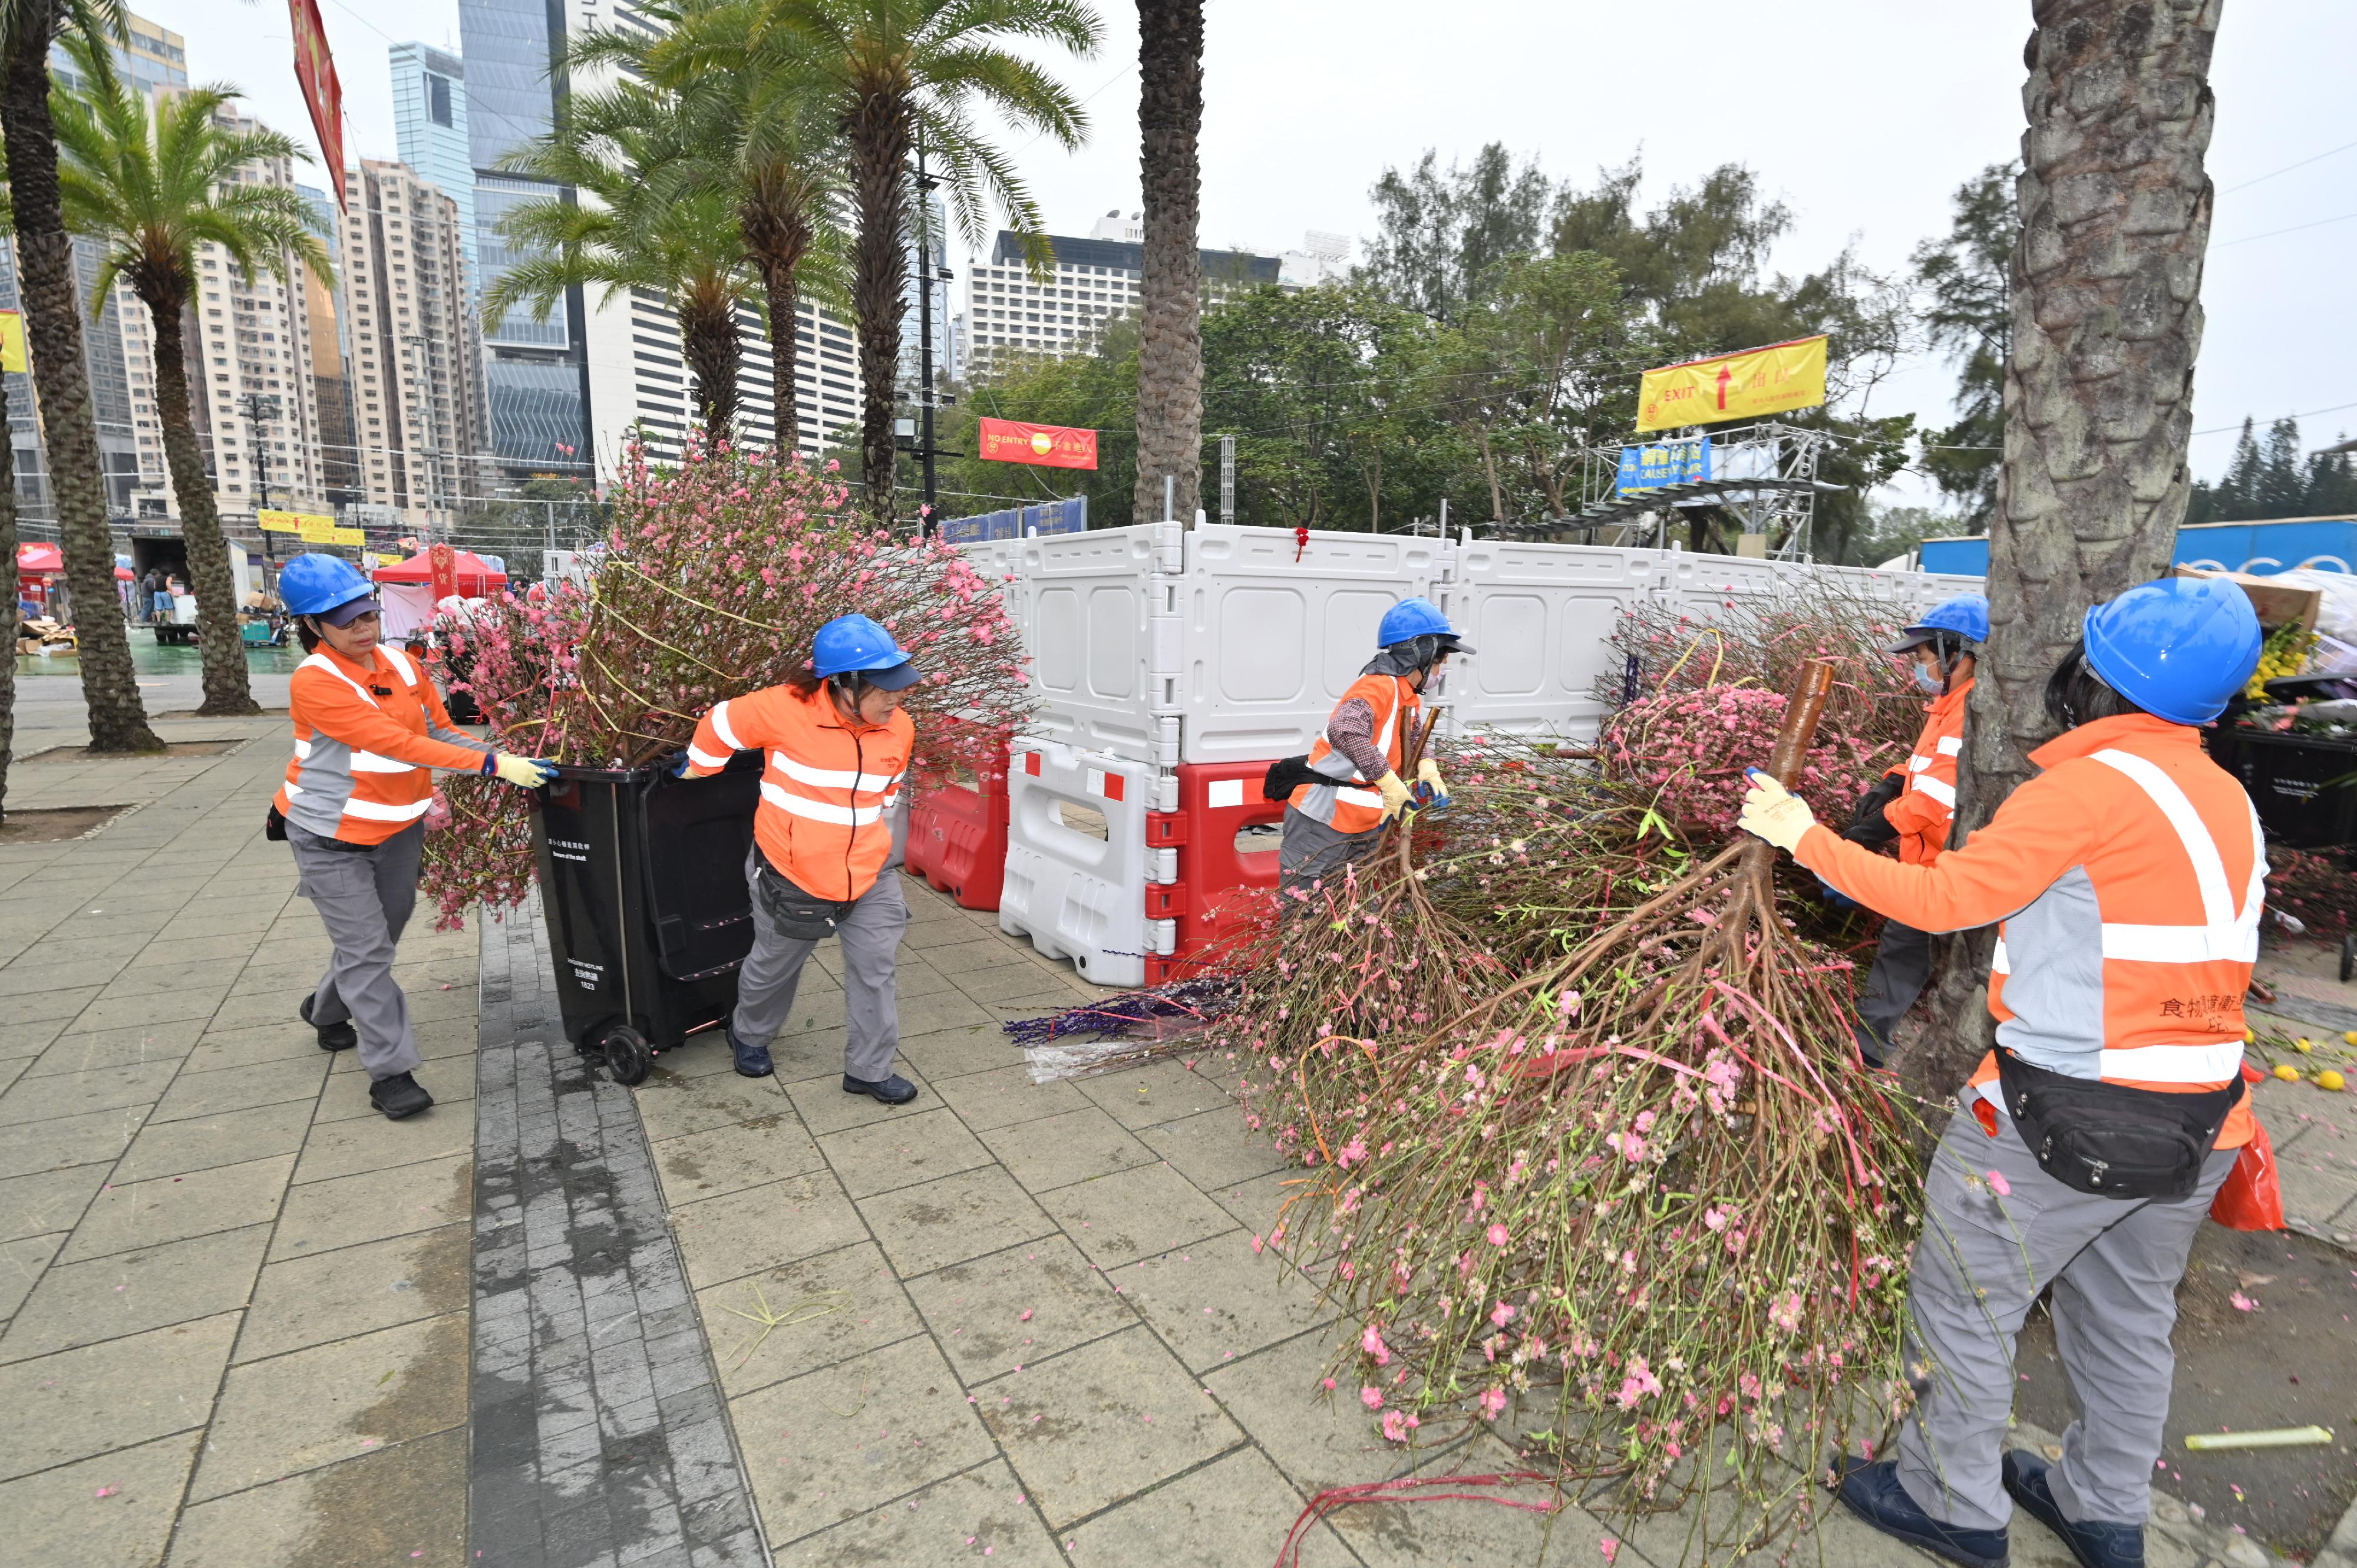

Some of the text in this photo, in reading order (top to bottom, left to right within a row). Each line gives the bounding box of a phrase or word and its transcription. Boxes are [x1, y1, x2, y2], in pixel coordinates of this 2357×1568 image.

[1752, 367, 1790, 389] 出口
[1664, 386, 1695, 402] EXIT
[988, 434, 1029, 445] NO ENTRY
[584, 962, 605, 971] HOTLINE
[580, 981, 595, 991] 1823
